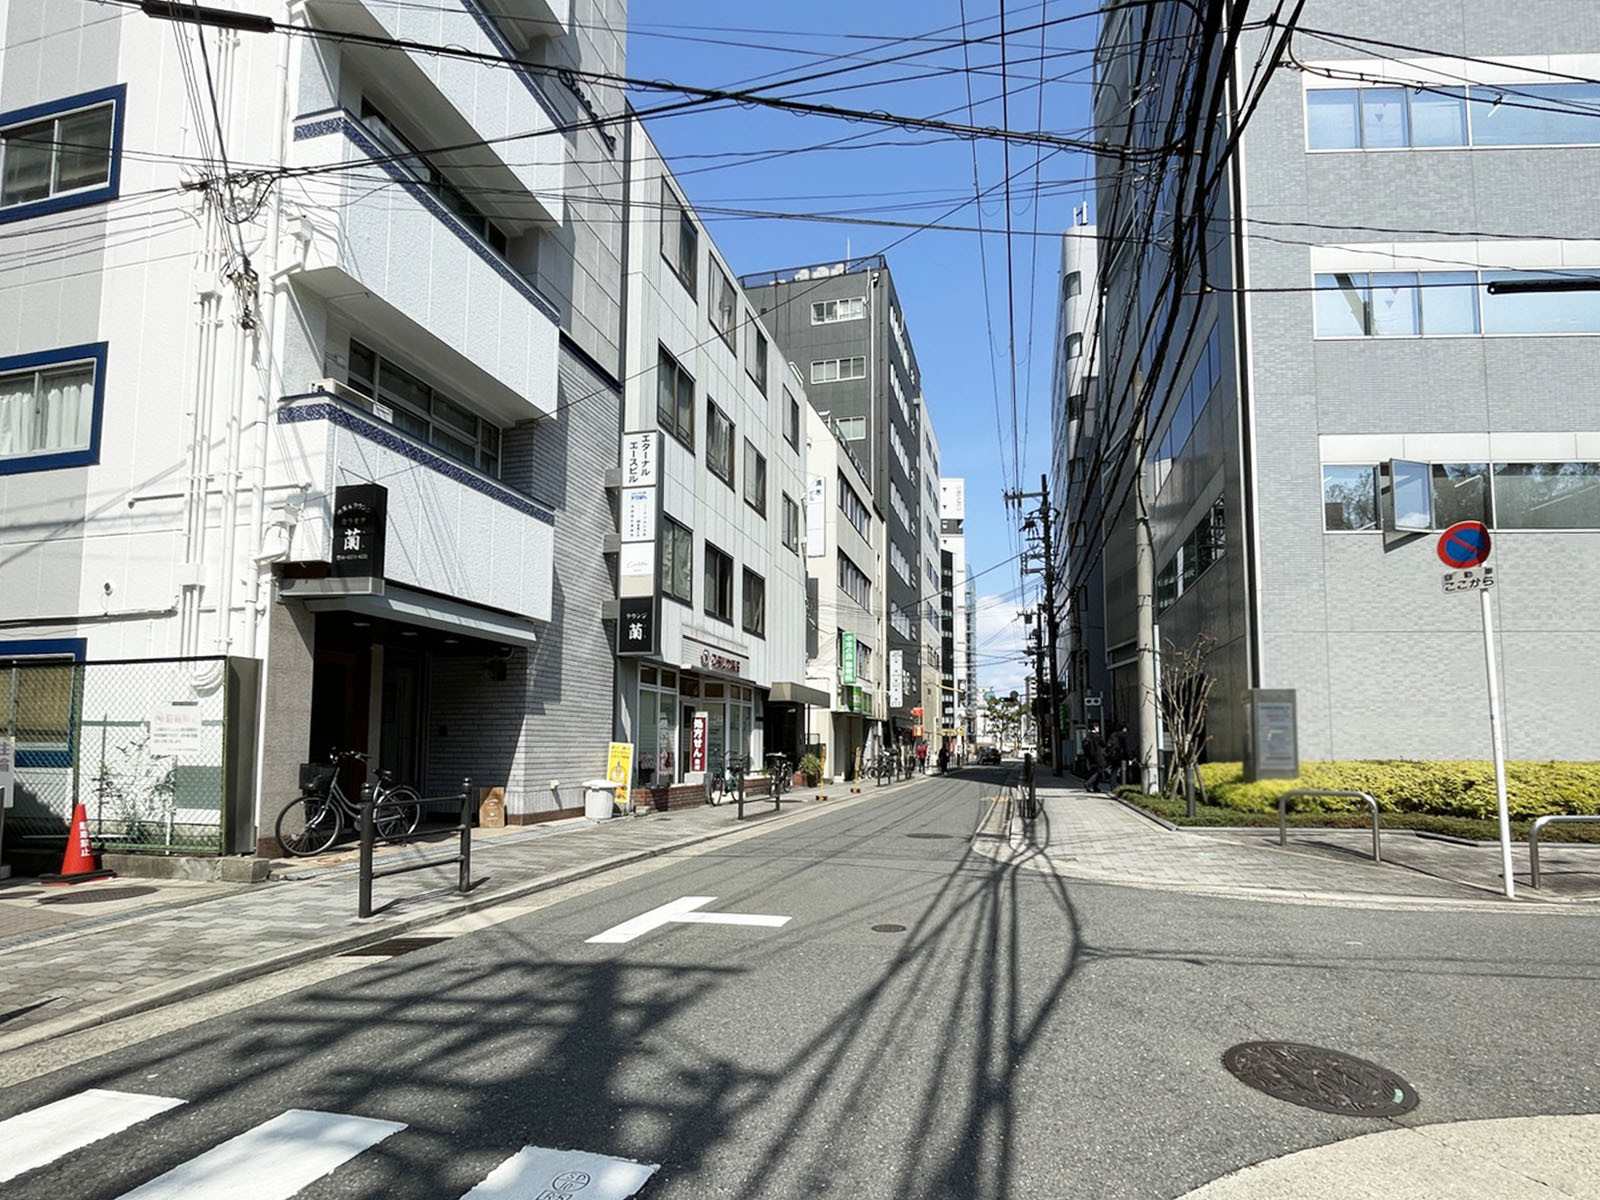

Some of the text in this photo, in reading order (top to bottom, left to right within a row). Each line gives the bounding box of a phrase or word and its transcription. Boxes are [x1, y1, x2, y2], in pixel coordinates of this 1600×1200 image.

[628, 441, 639, 484] エースビル
[641, 434, 651, 477] エターナル
[343, 527, 362, 552] 蘭
[1444, 576, 1495, 592] ここから
[628, 622, 643, 641] 蘭
